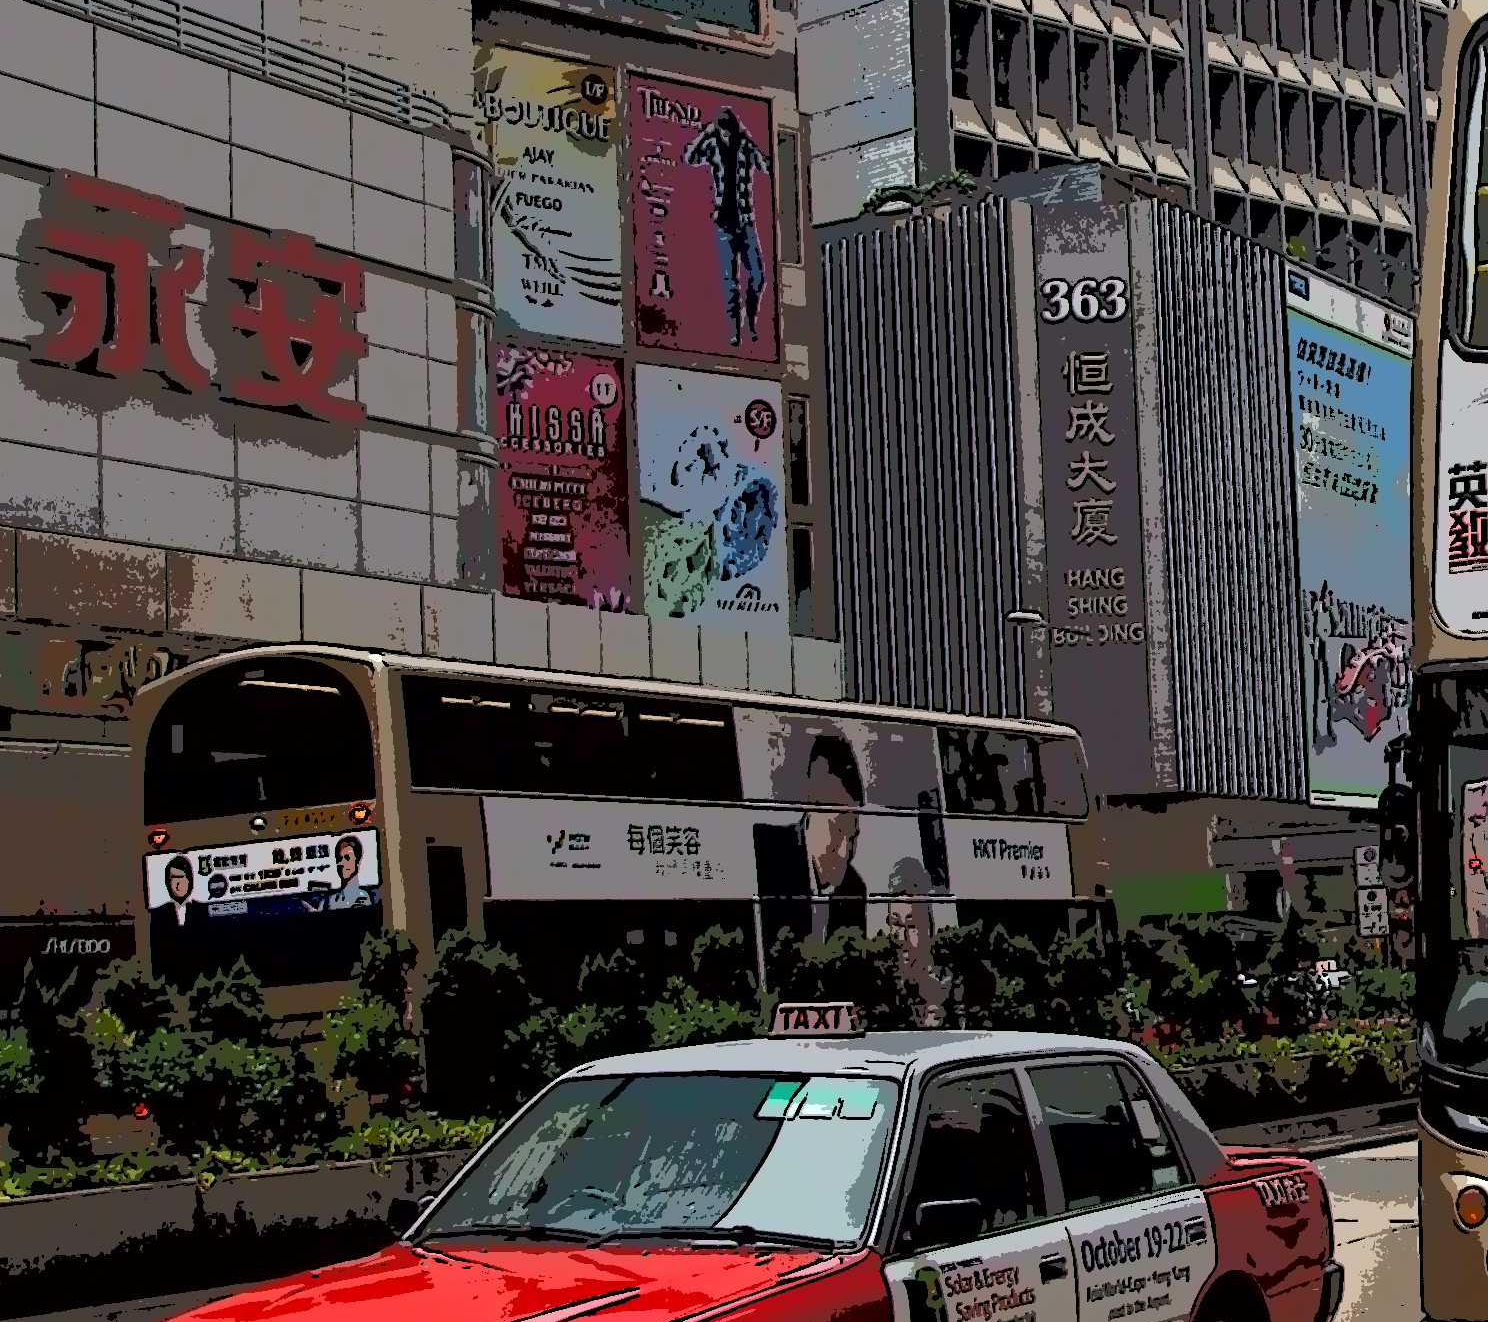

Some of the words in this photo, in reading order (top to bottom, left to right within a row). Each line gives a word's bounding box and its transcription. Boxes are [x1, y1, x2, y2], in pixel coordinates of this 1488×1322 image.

[516, 192, 562, 212] FUEGO
[42, 174, 368, 424] 永安
[1041, 277, 1129, 324] 363
[1064, 566, 1126, 590] HANG
[1066, 594, 1128, 618] SHING
[973, 838, 998, 860] HKT
[999, 839, 1044, 861] Premier
[778, 1006, 845, 1031] TAXI
[1081, 1229, 1141, 1273] October
[1144, 1220, 1186, 1259] 19-22
